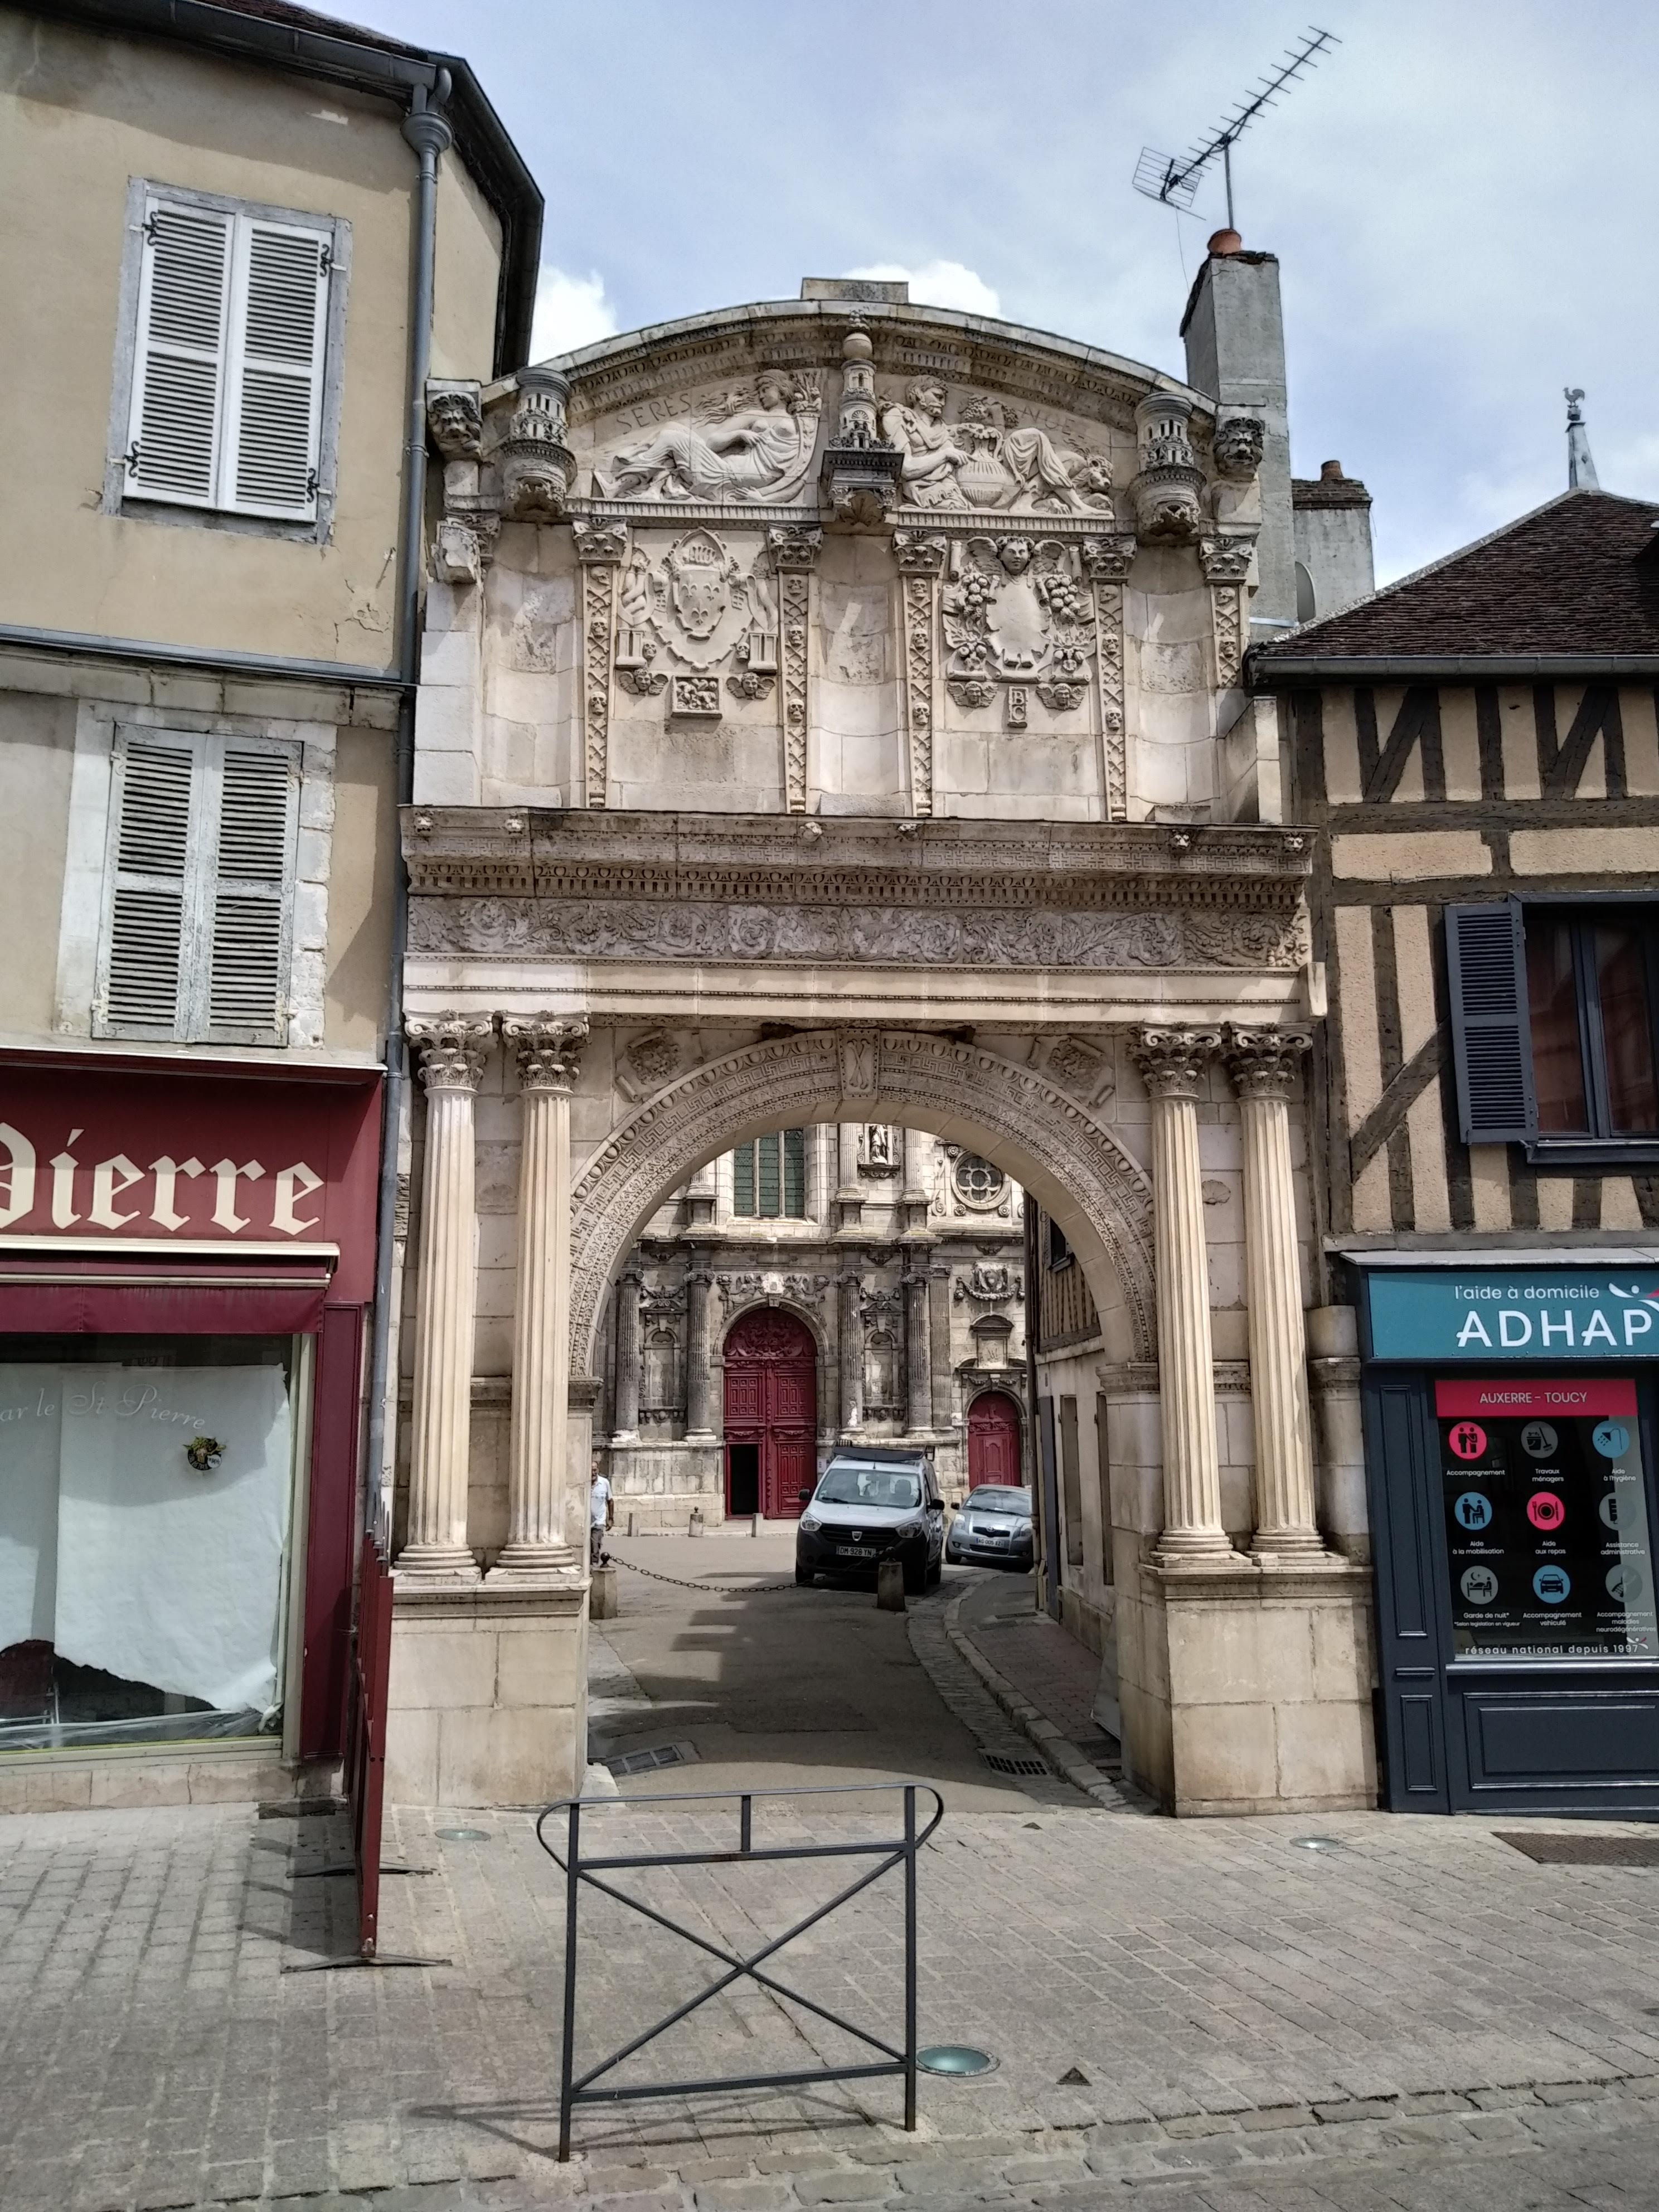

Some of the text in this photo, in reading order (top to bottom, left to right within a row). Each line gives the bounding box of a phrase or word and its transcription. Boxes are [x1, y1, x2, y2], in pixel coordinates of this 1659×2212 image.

[616, 392, 691, 435] SERES
[1454, 1284, 1599, 1299] l'aide à domicile
[1456, 1309, 1652, 1347] ADHAP
[36, 1388, 55, 1417] le
[67, 1380, 106, 1415] St
[114, 1384, 205, 1429] Pierre
[1479, 1393, 1532, 1404] AUXERRE
[1544, 1392, 1588, 1403] TOUCY
[1464, 1644, 1638, 1656] réseau national depuis 1997
